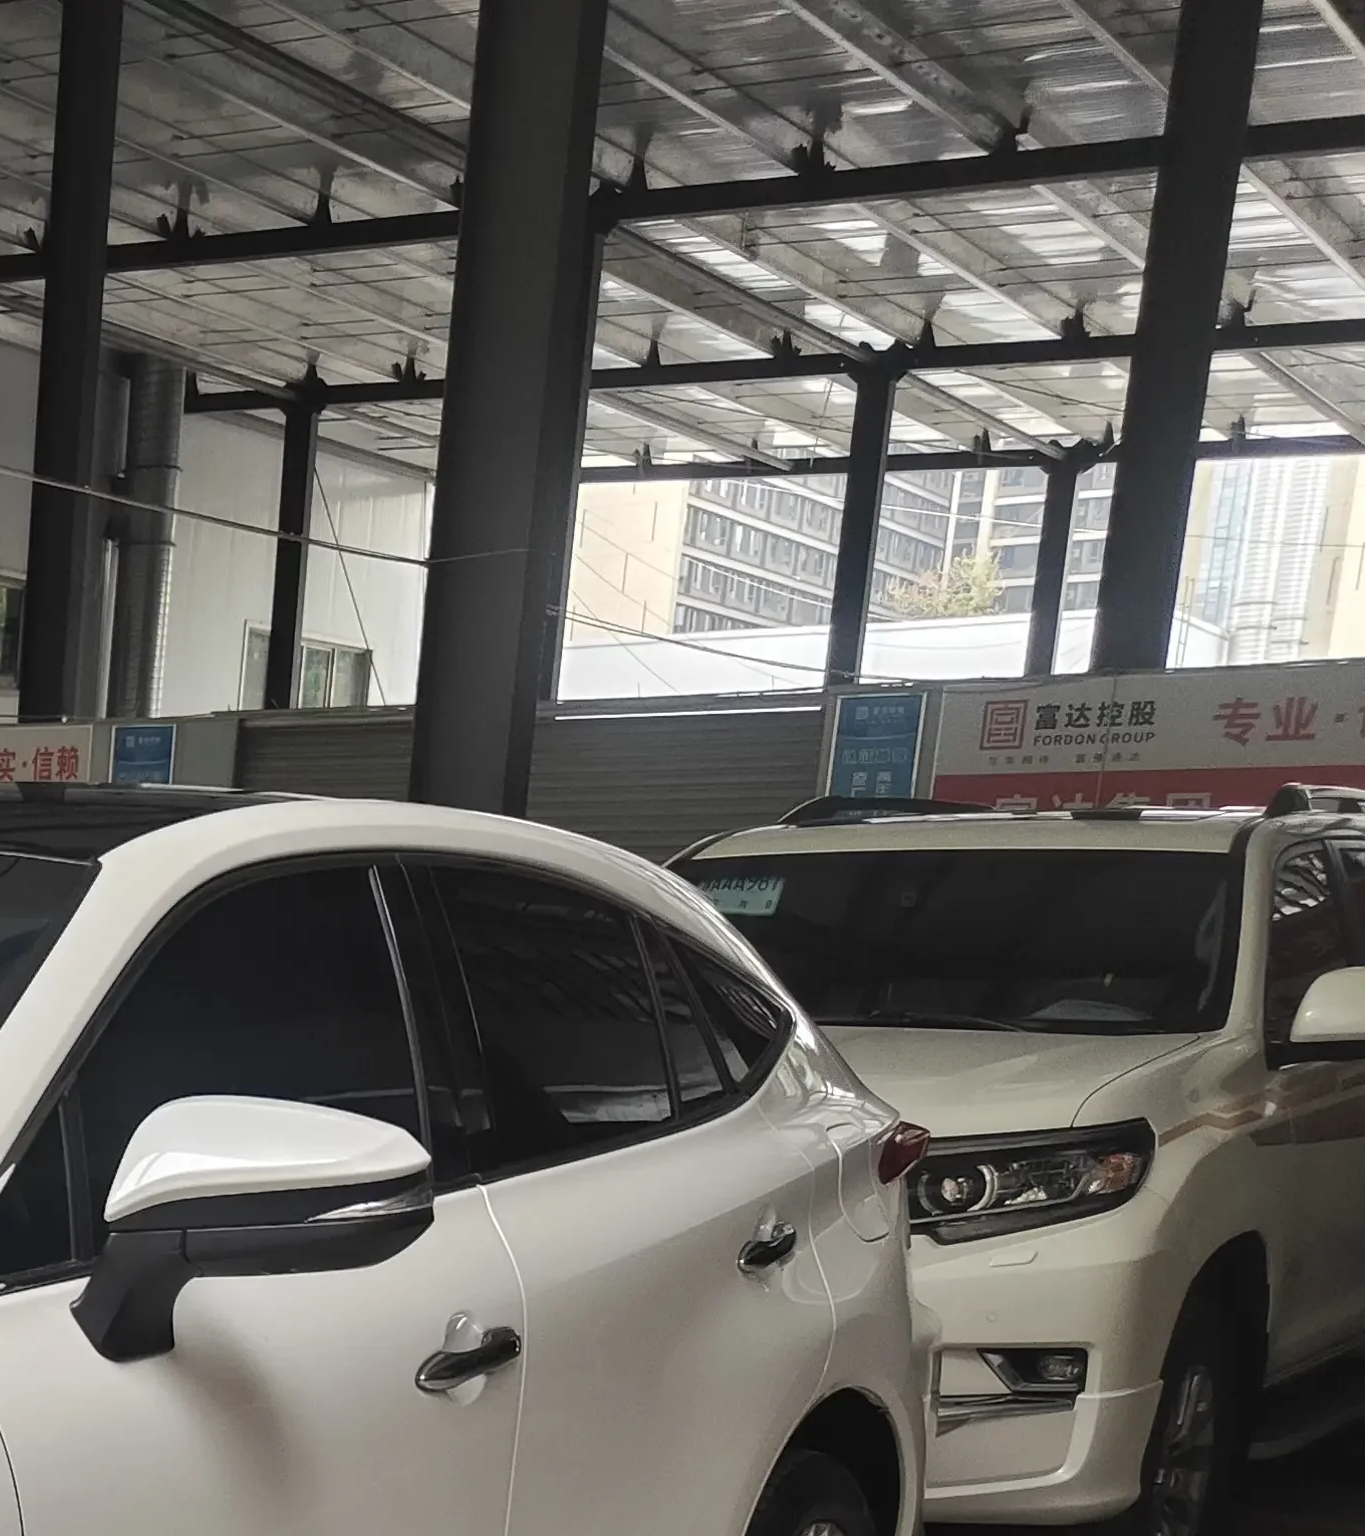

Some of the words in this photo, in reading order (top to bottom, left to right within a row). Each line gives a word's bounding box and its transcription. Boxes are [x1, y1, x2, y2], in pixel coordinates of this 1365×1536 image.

[1035, 700, 1157, 731] 富达控股
[1212, 696, 1365, 746] 专业·
[1033, 734, 1096, 747] FORDON
